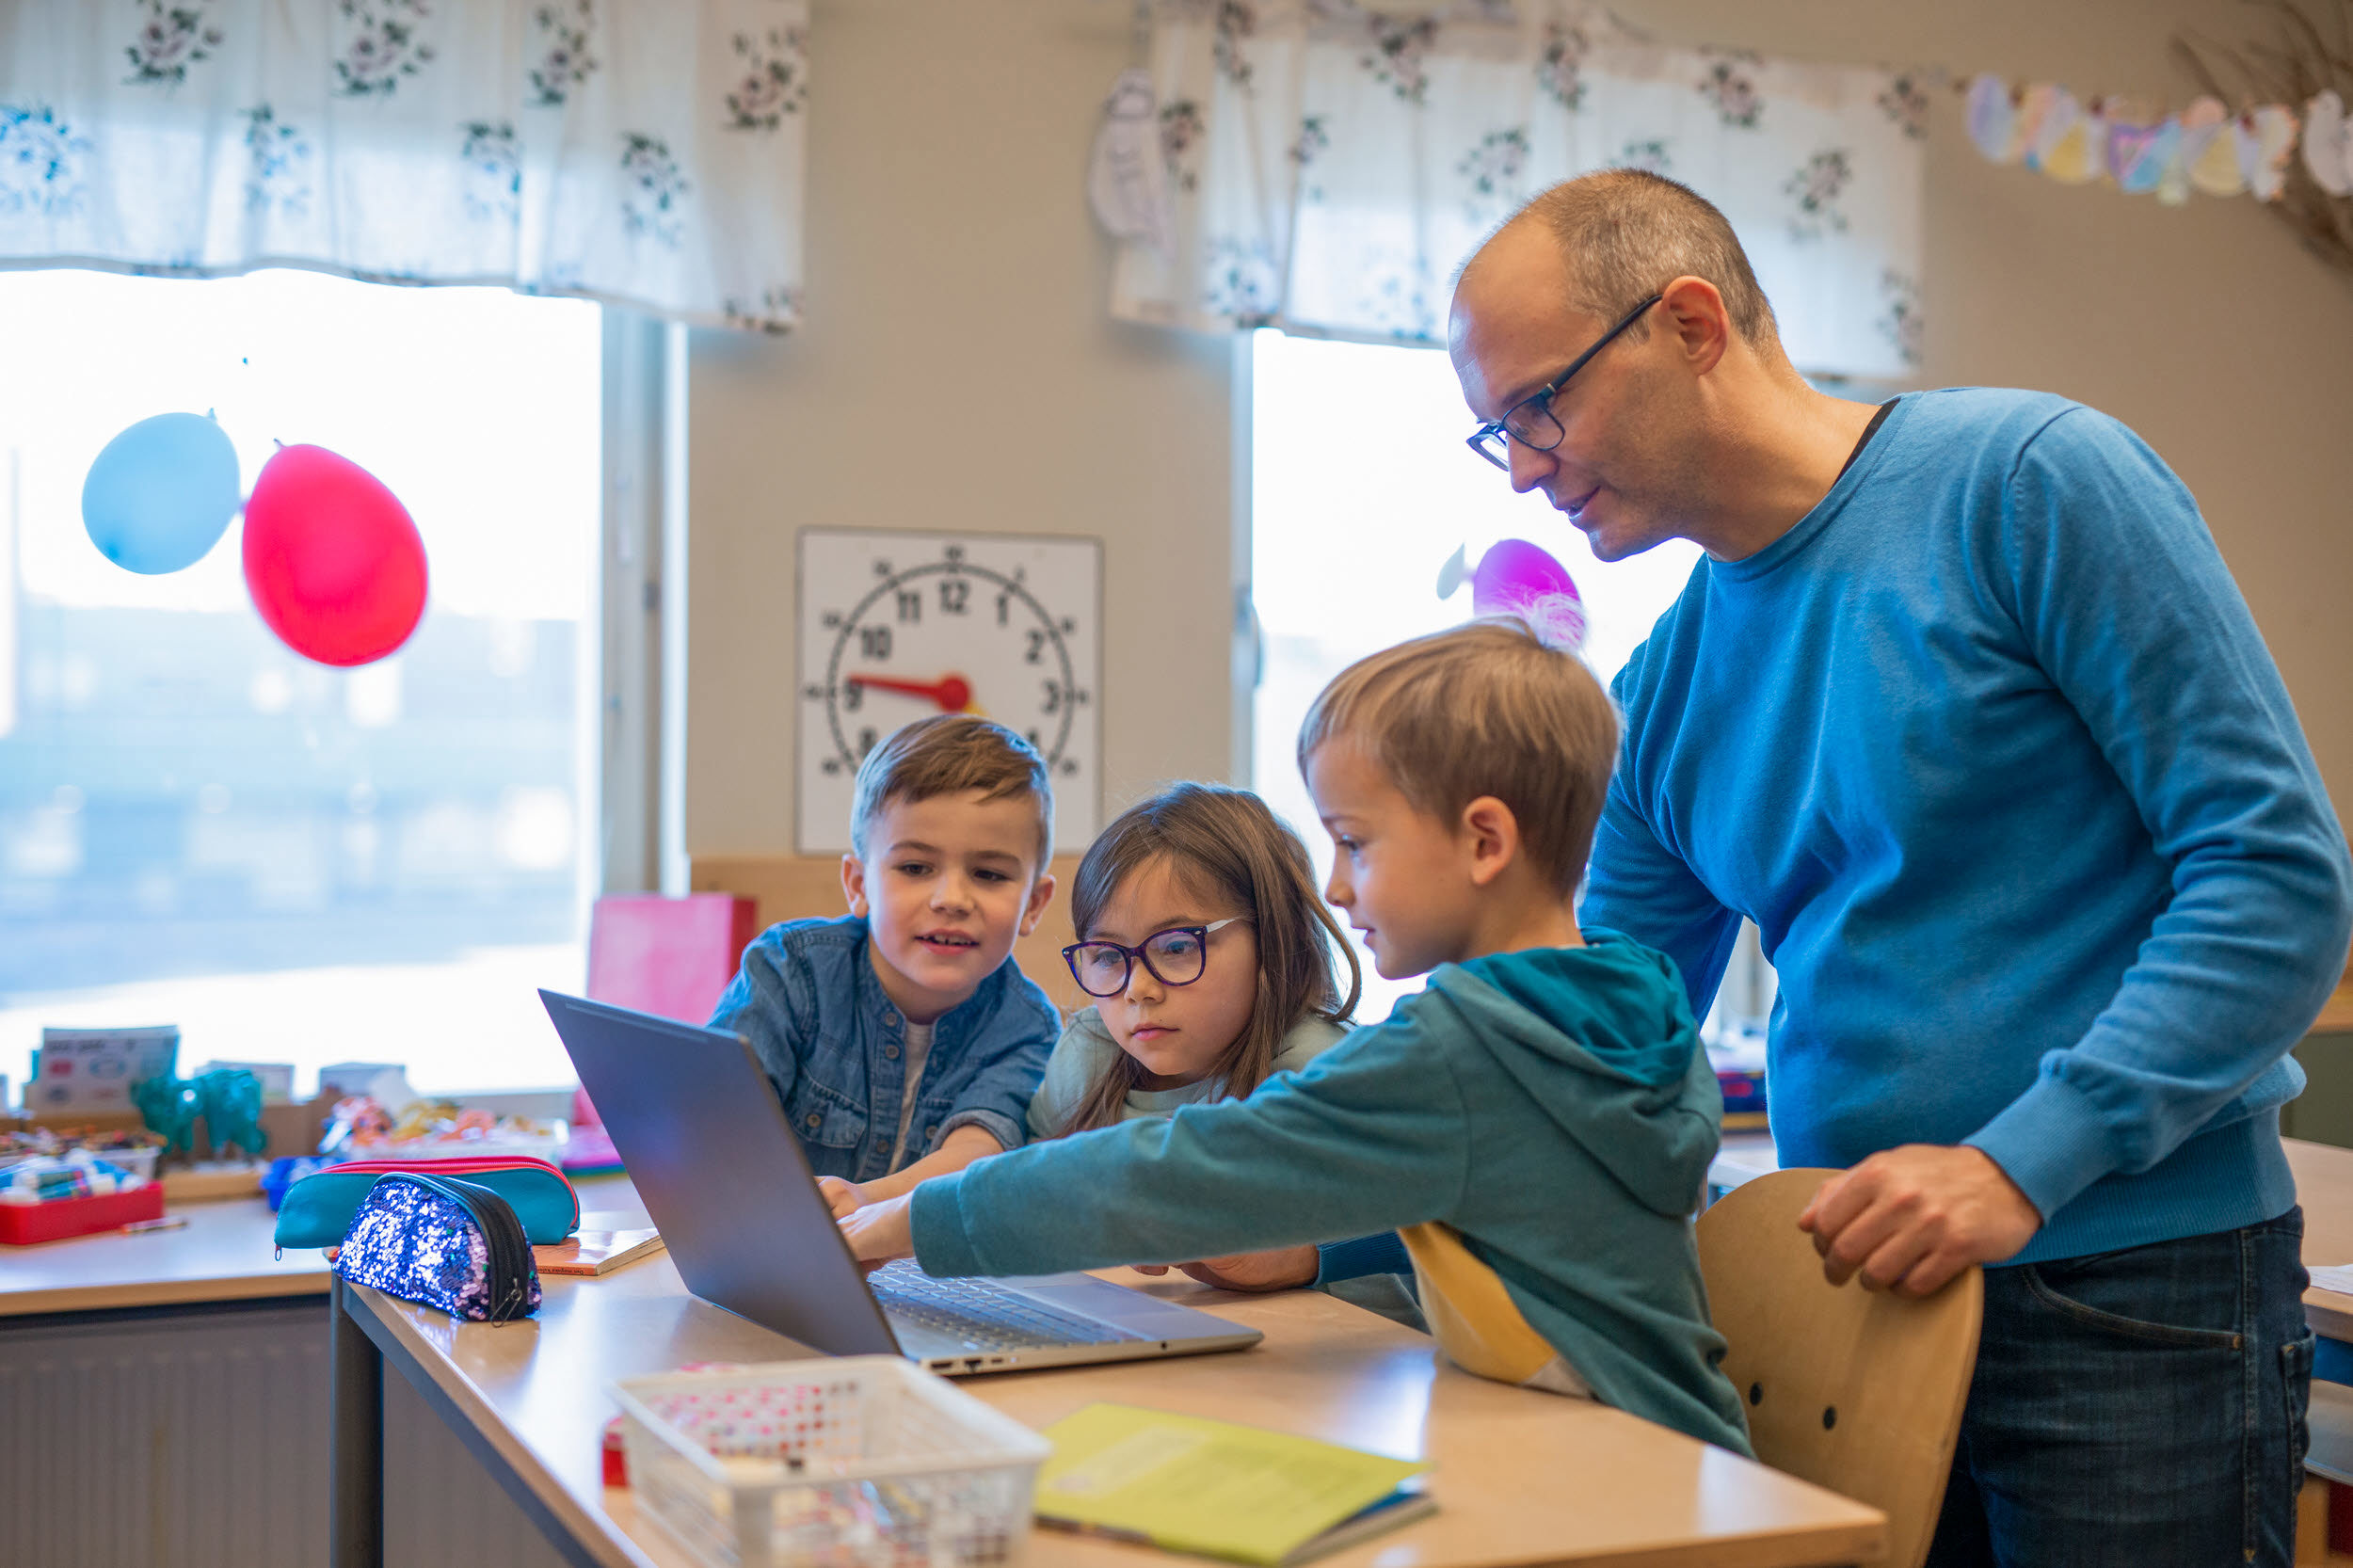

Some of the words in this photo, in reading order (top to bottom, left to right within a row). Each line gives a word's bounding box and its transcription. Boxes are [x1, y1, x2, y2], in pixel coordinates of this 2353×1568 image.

[897, 590, 921, 623] 11
[939, 580, 969, 614] 12
[996, 592, 1008, 626] 1
[860, 626, 891, 659] 10
[1026, 629, 1045, 664] 2
[1042, 680, 1060, 714] 3
